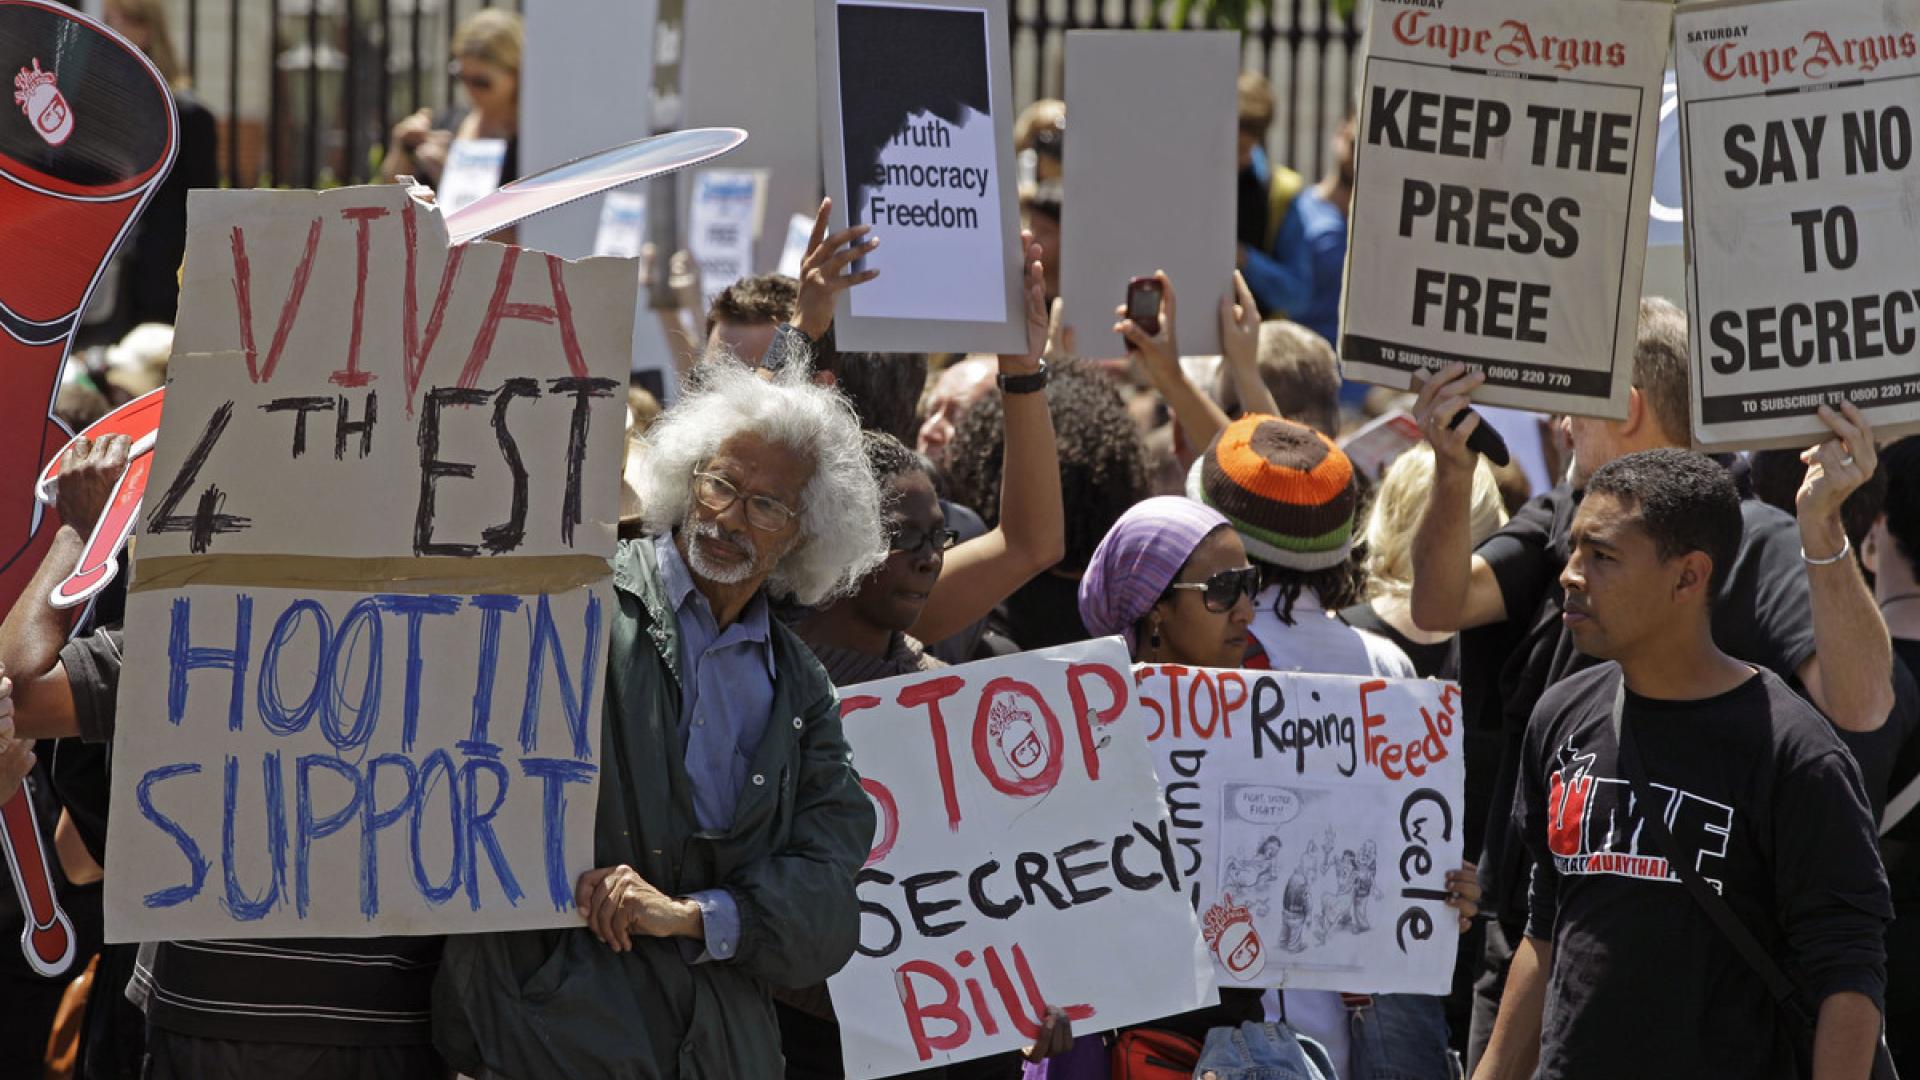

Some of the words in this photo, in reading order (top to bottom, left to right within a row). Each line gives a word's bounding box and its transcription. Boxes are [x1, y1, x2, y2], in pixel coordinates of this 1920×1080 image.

[1391, 9, 1493, 59] Cape
[1494, 19, 1627, 71] Argus
[1687, 25, 1748, 43] SATURDAY
[1703, 43, 1798, 84] Cape
[1802, 31, 1917, 79] Argus
[893, 119, 951, 148] ruth
[1368, 86, 1511, 159] KEEP
[1527, 105, 1633, 175] THE
[1724, 115, 1827, 189] SAY
[1843, 105, 1912, 175] NO
[870, 196, 980, 228] Freedom
[871, 163, 989, 197] emocracy
[1399, 178, 1581, 259] PRESS
[1792, 205, 1858, 273] TO
[230, 200, 591, 420] VIVA
[1411, 268, 1551, 344] FREE
[1709, 289, 1920, 375] SECREC
[1381, 347, 1396, 360] TO
[1488, 366, 1518, 380] 0800
[1521, 370, 1545, 384] 220
[1549, 373, 1571, 387] 770
[1742, 400, 1757, 413] TO
[1760, 393, 1825, 412] SUBSCRIBE
[1851, 387, 1878, 402] 0800
[1881, 384, 1901, 398] 220
[413, 376, 620, 557] EST
[168, 594, 462, 765] HOOT
[455, 589, 602, 760] IN
[1135, 664, 1248, 742] STOP
[1252, 676, 1357, 777] Raping
[136, 748, 598, 922] SUPPORT
[854, 819, 1181, 957] SECRECY
